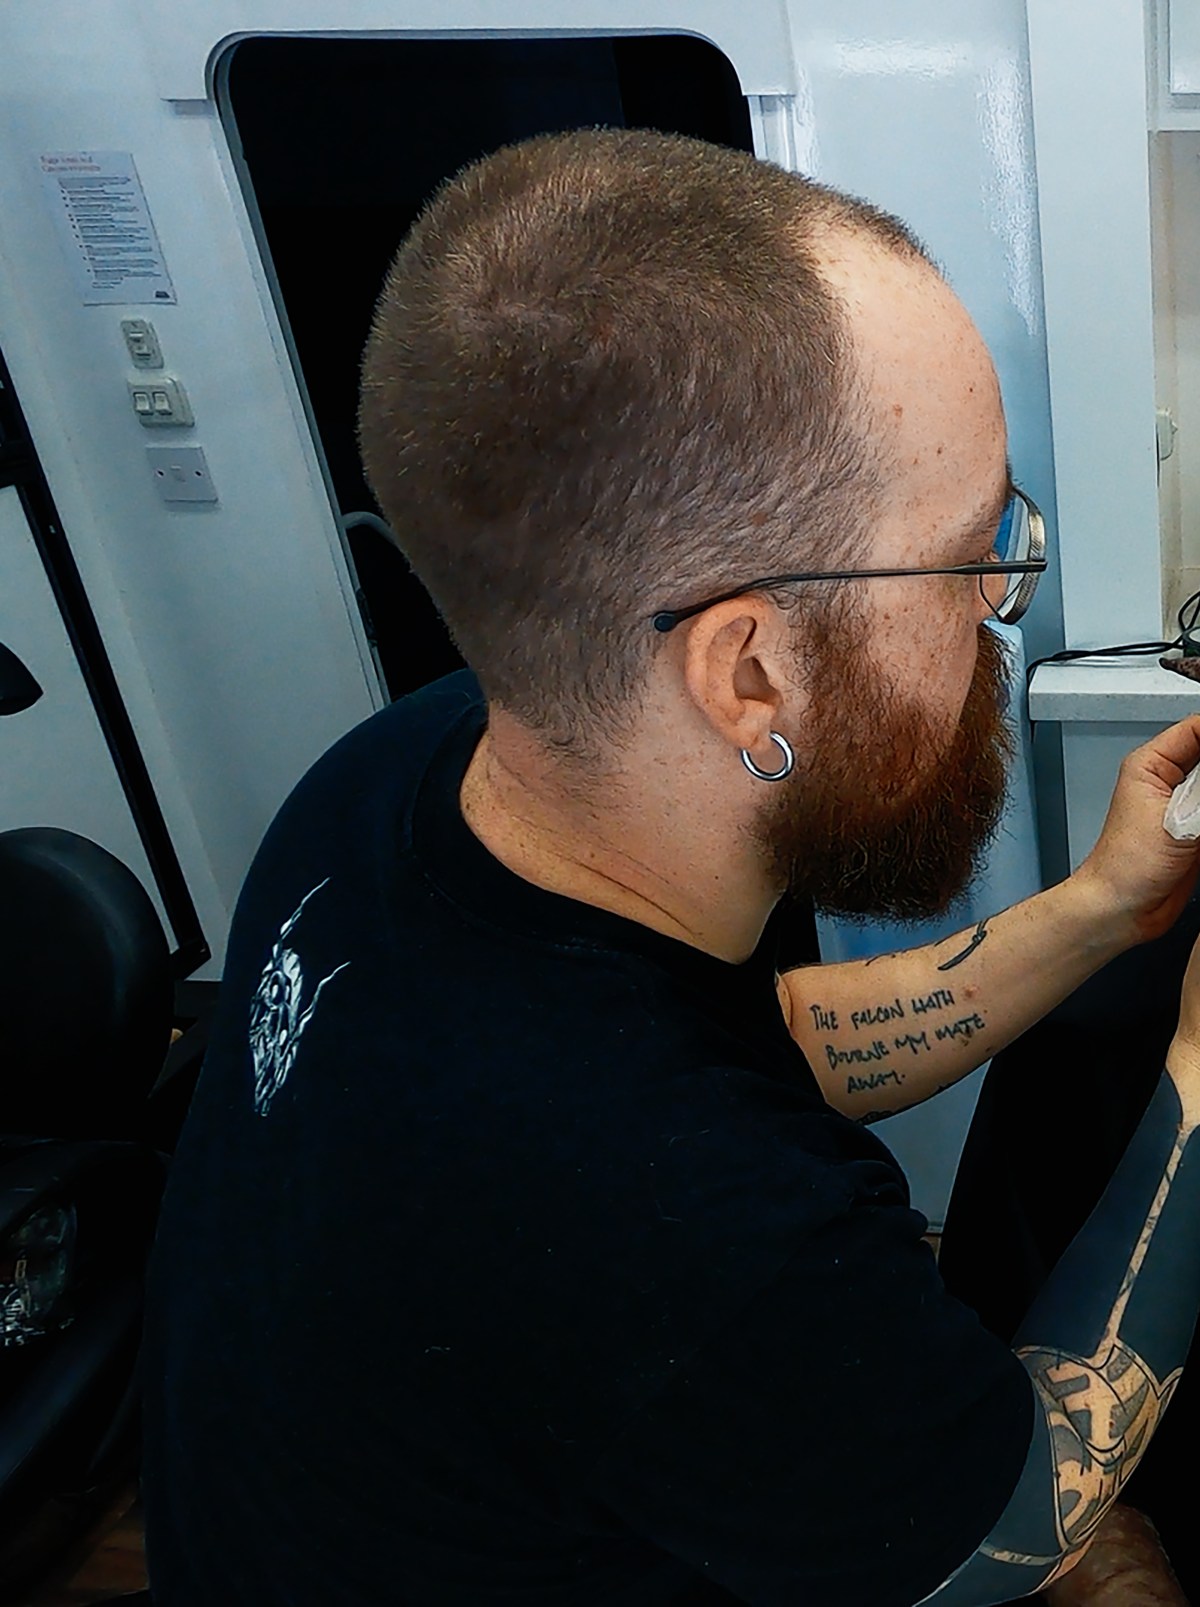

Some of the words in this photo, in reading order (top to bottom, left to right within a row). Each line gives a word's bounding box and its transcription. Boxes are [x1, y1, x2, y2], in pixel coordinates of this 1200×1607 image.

[809, 1004, 838, 1031] THE
[851, 998, 904, 1030] FALCON
[911, 989, 956, 1014] HATH
[825, 1040, 889, 1070] BOURNE
[934, 1013, 986, 1039] MATE
[847, 1071, 905, 1094] AWAY.
